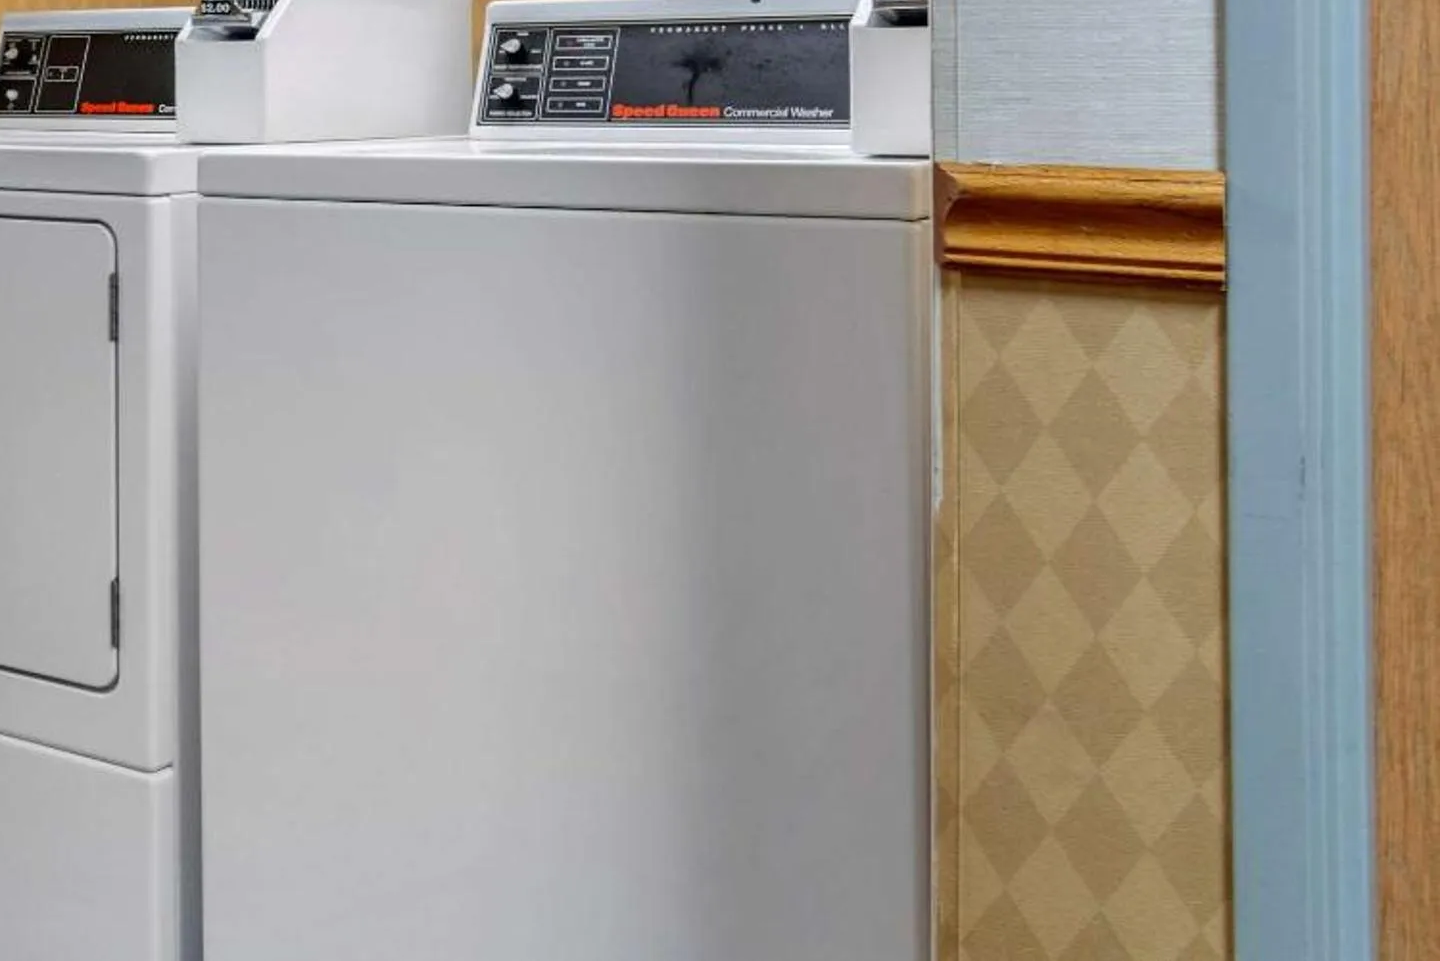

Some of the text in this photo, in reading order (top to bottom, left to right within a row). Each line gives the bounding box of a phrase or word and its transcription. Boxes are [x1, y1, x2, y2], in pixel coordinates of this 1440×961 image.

[612, 103, 834, 120] Speed Queen Commercial Washer
